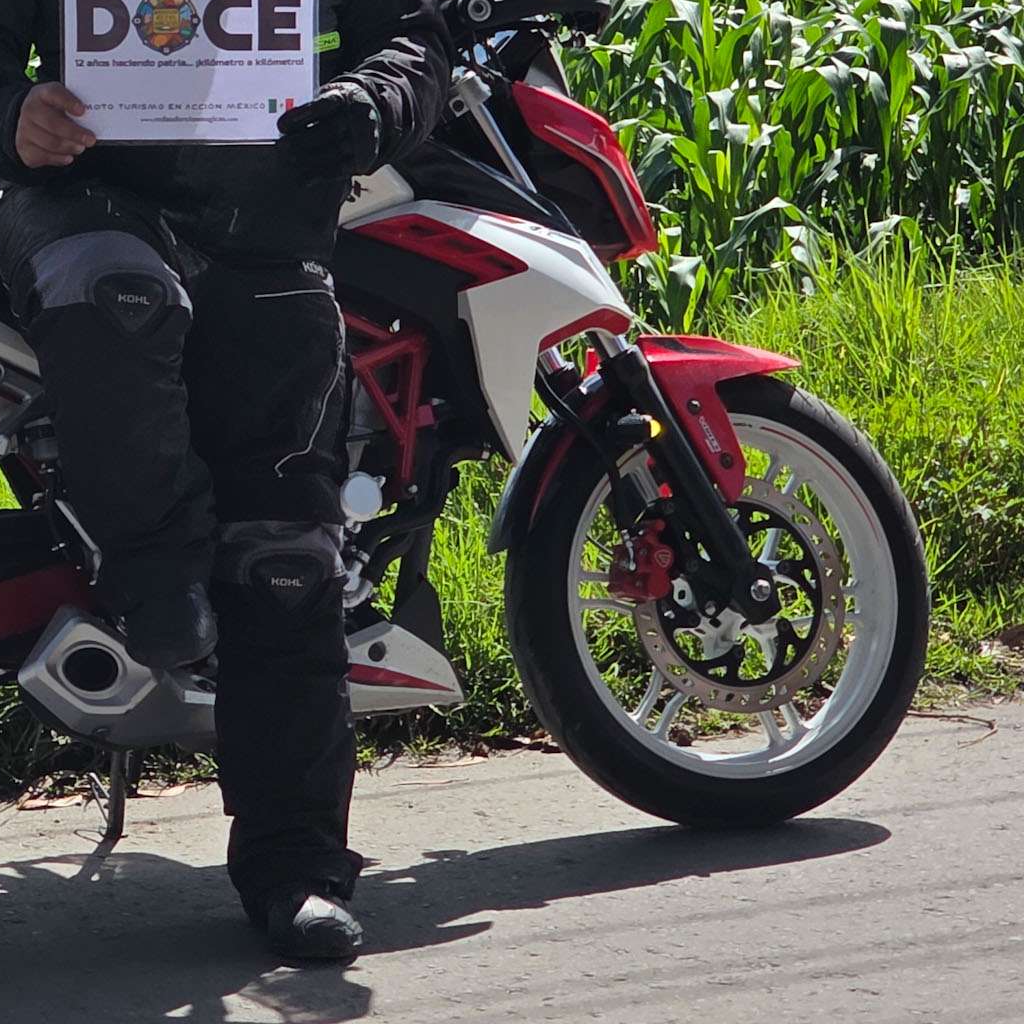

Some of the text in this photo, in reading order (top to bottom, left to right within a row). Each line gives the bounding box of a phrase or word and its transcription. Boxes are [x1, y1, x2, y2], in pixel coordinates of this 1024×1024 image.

[75, 59, 86, 67] 12
[112, 59, 156, 67] haciendo
[83, 103, 115, 111] MOTO
[118, 103, 165, 111] TURISMO
[168, 103, 182, 111] EN
[118, 293, 151, 305] KOHL
[271, 576, 303, 587] KOHL
